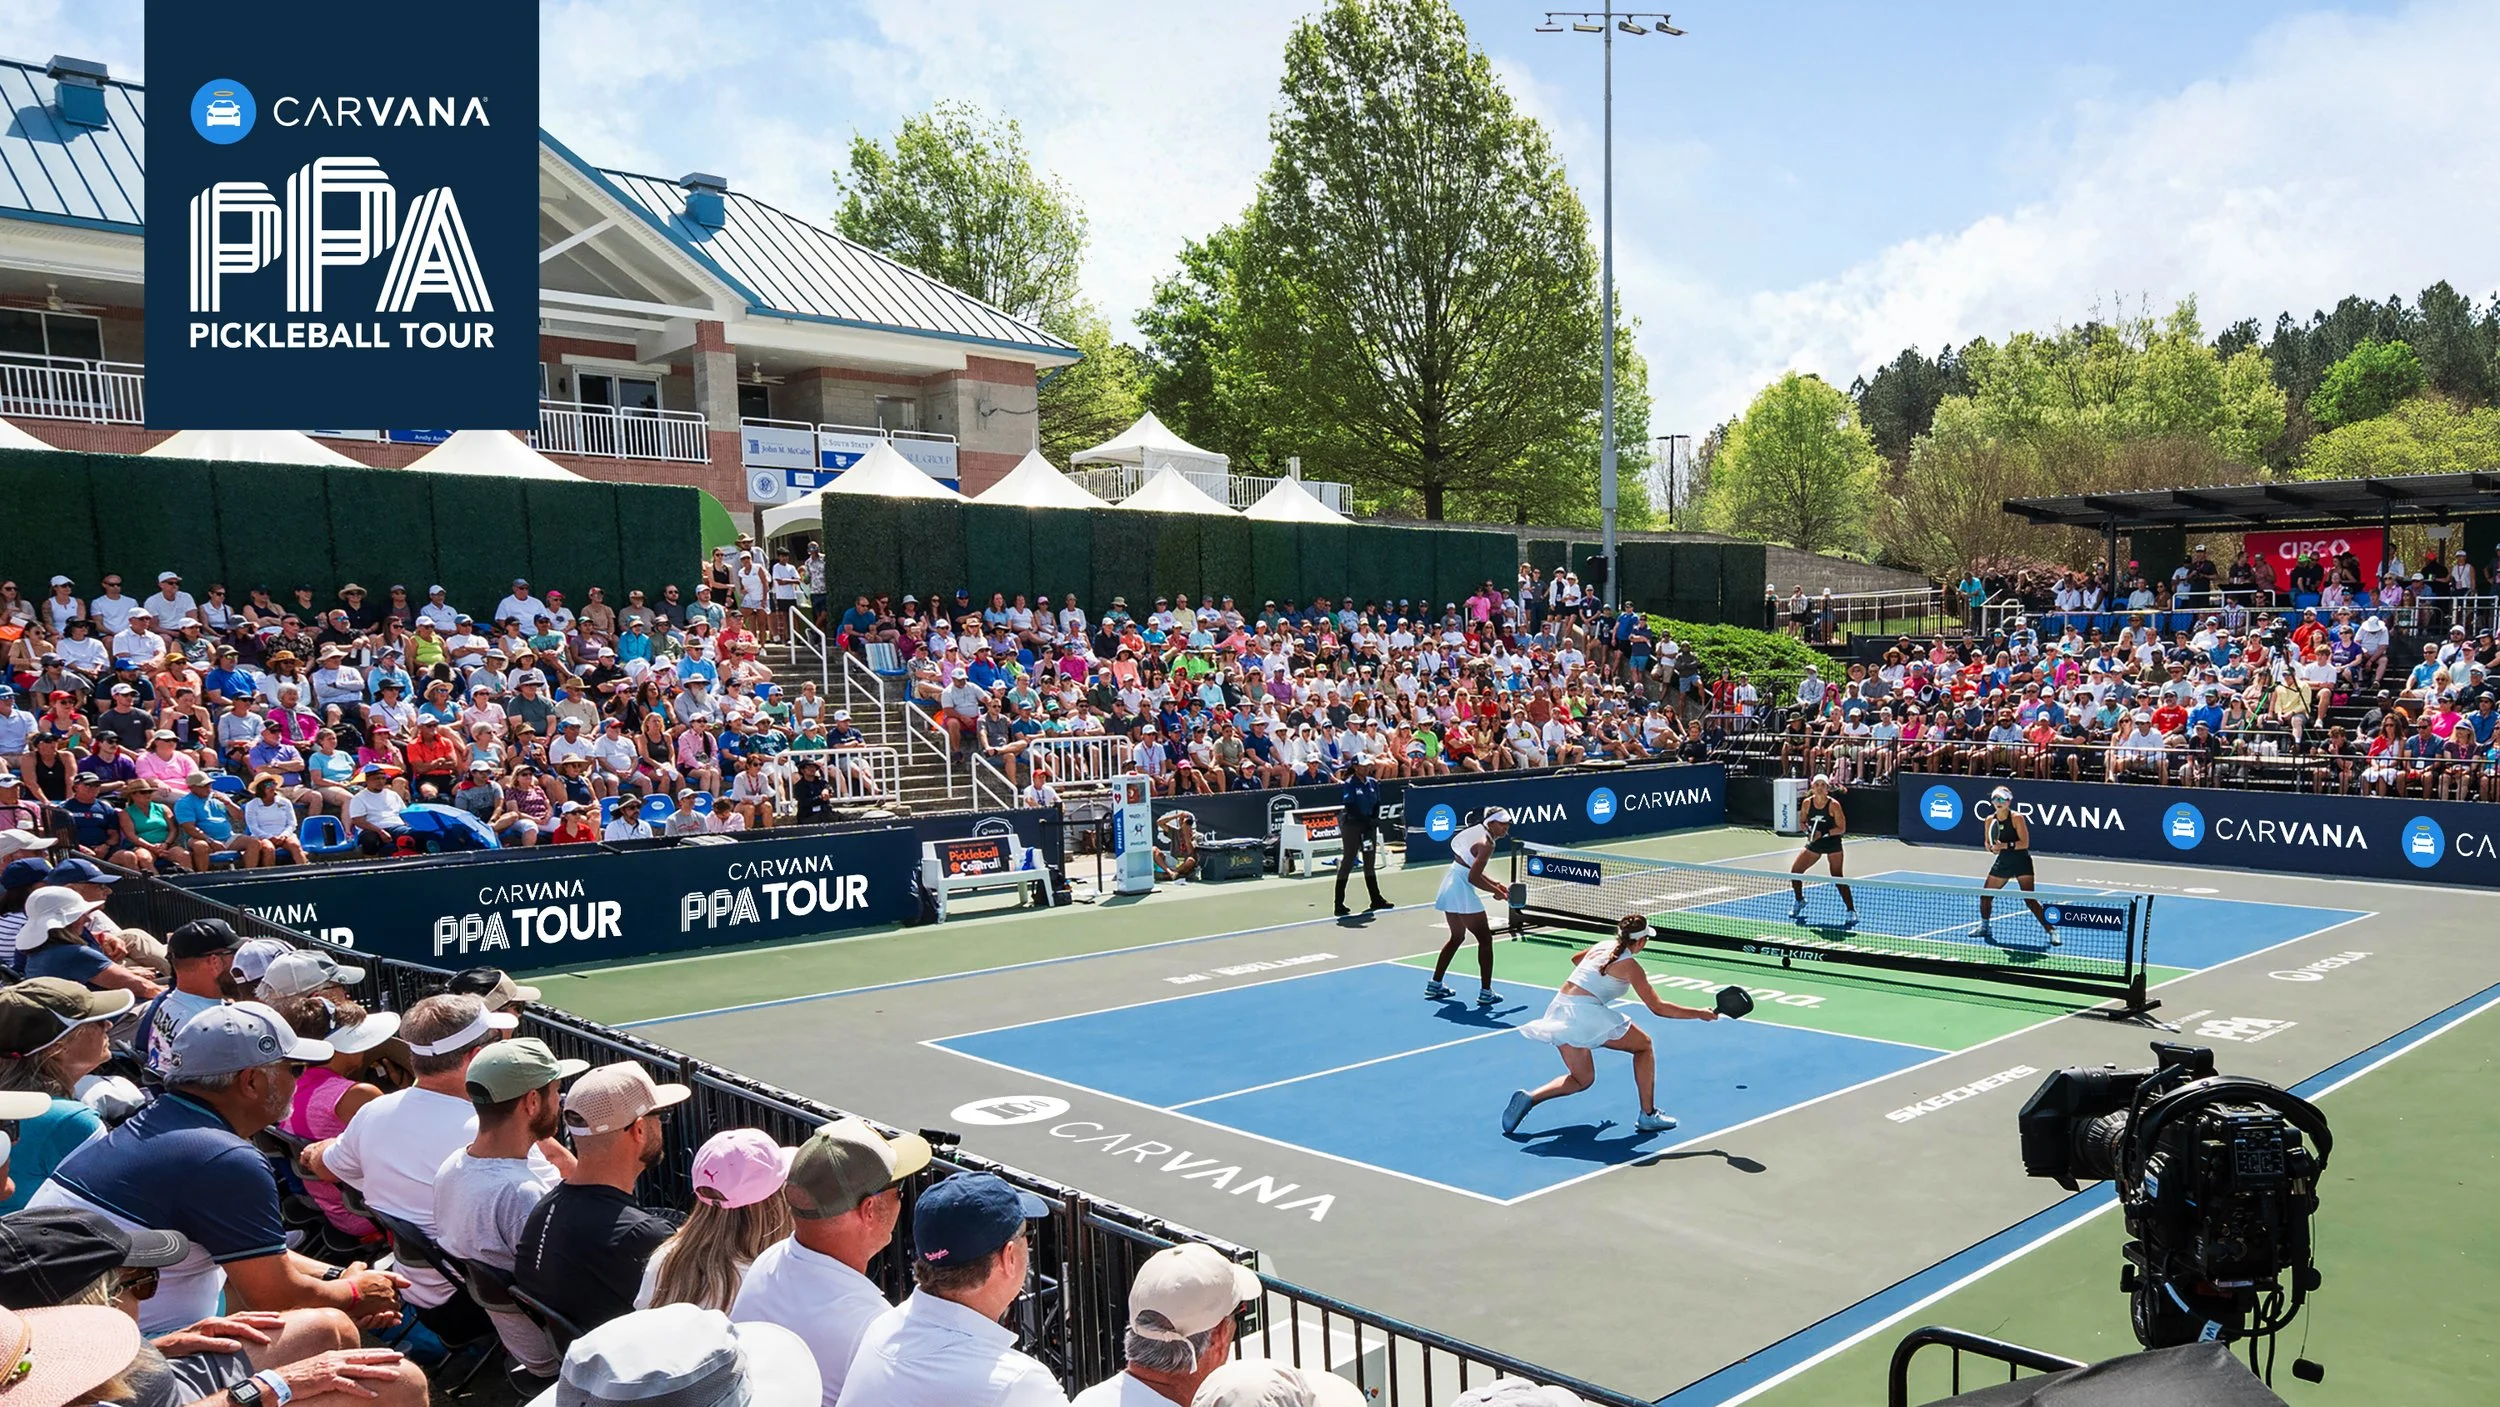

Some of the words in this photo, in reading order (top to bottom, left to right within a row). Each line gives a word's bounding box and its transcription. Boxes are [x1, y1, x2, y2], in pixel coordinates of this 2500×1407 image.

[1624, 786, 1712, 811] CARVANA
[1464, 803, 1568, 828] CVANA
[1973, 800, 2126, 831] CRVANA
[2215, 817, 2368, 850] CARVANA
[2455, 832, 2497, 859] CA
[948, 846, 999, 861] Pickleball
[728, 854, 834, 881] CARVANA
[1546, 863, 1600, 879] CARVANA
[478, 879, 586, 906] CARVANA
[681, 886, 761, 933] PPA
[762, 874, 869, 920] TOUR
[434, 912, 511, 957] PPA
[512, 900, 622, 947] TOUR
[2064, 911, 2122, 925] CARVANA
[1760, 945, 1825, 962] SELKIRK
[1884, 1064, 2041, 1124] SKECHERS
[1048, 1122, 1337, 1223] CARVANA
